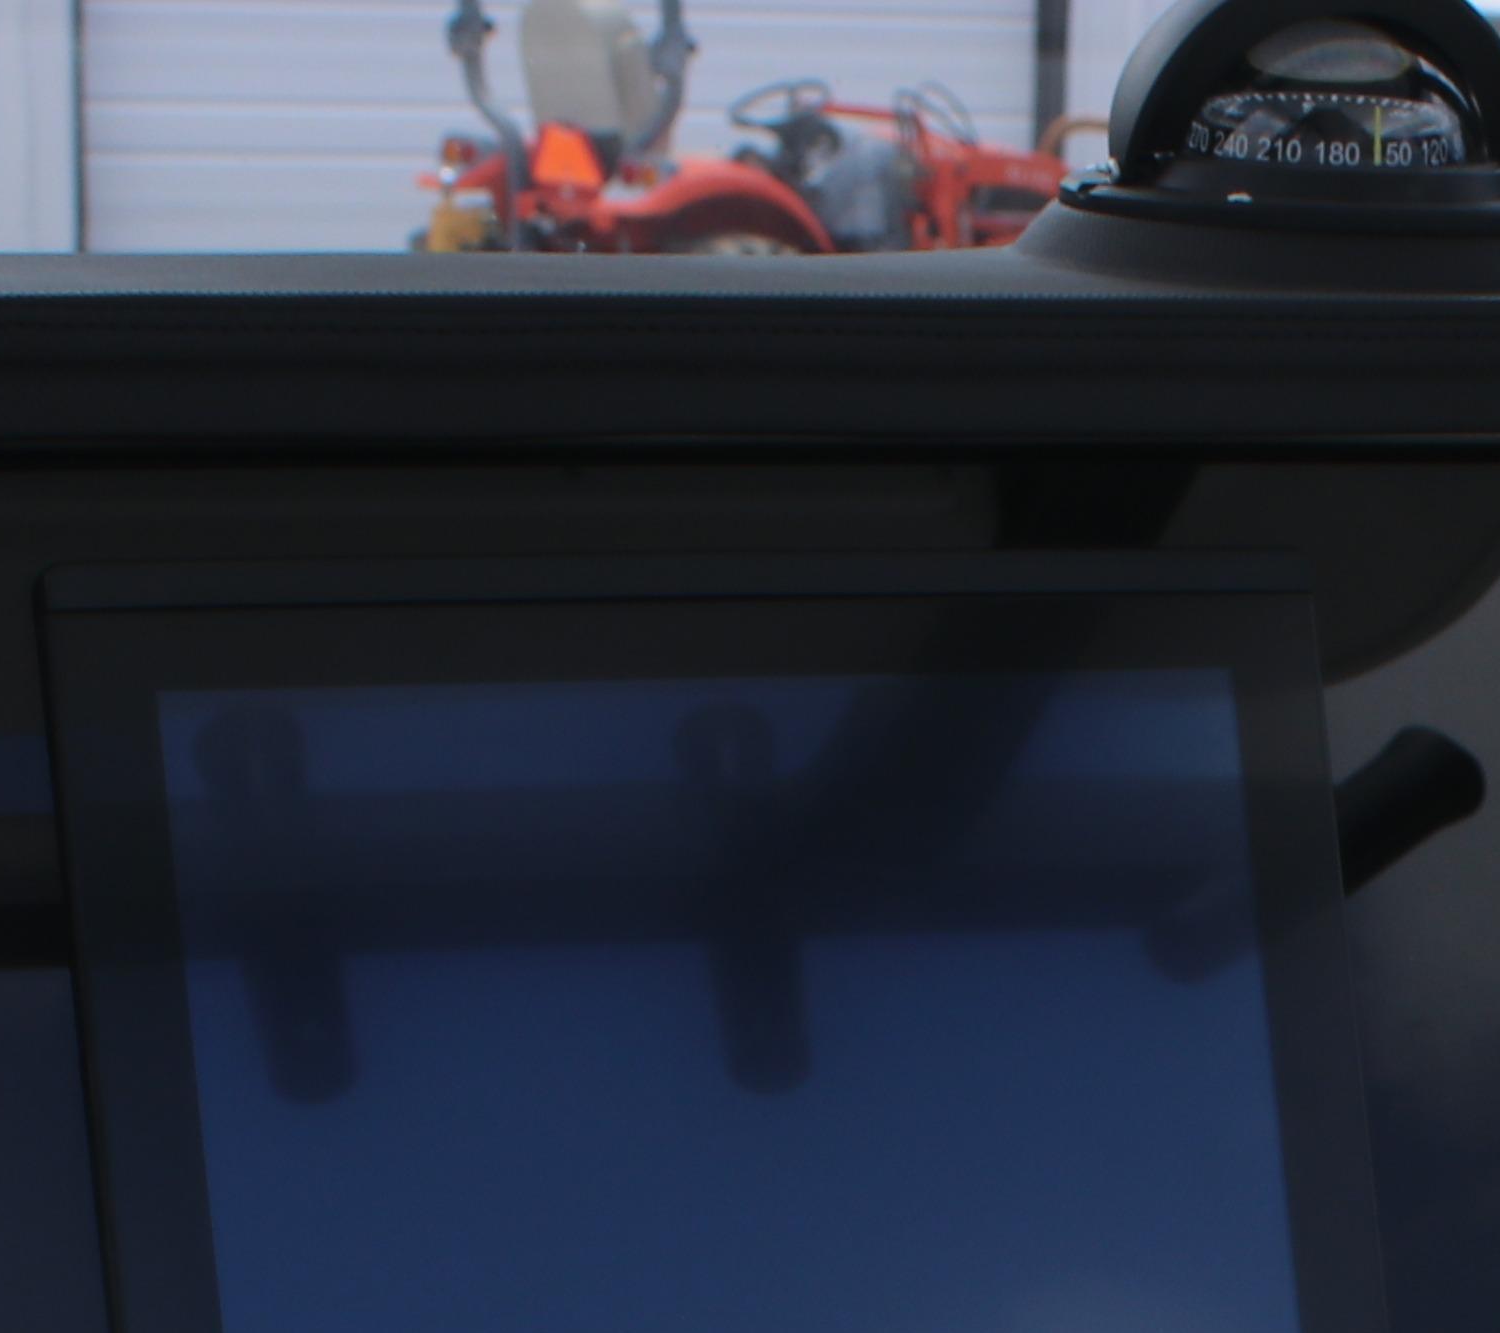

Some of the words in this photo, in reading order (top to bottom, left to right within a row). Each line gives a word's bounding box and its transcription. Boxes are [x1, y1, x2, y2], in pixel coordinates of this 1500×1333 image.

[1214, 131, 1248, 159] 240
[1257, 137, 1302, 163] 210
[1315, 141, 1360, 166] 180
[1421, 140, 1448, 165] 120
